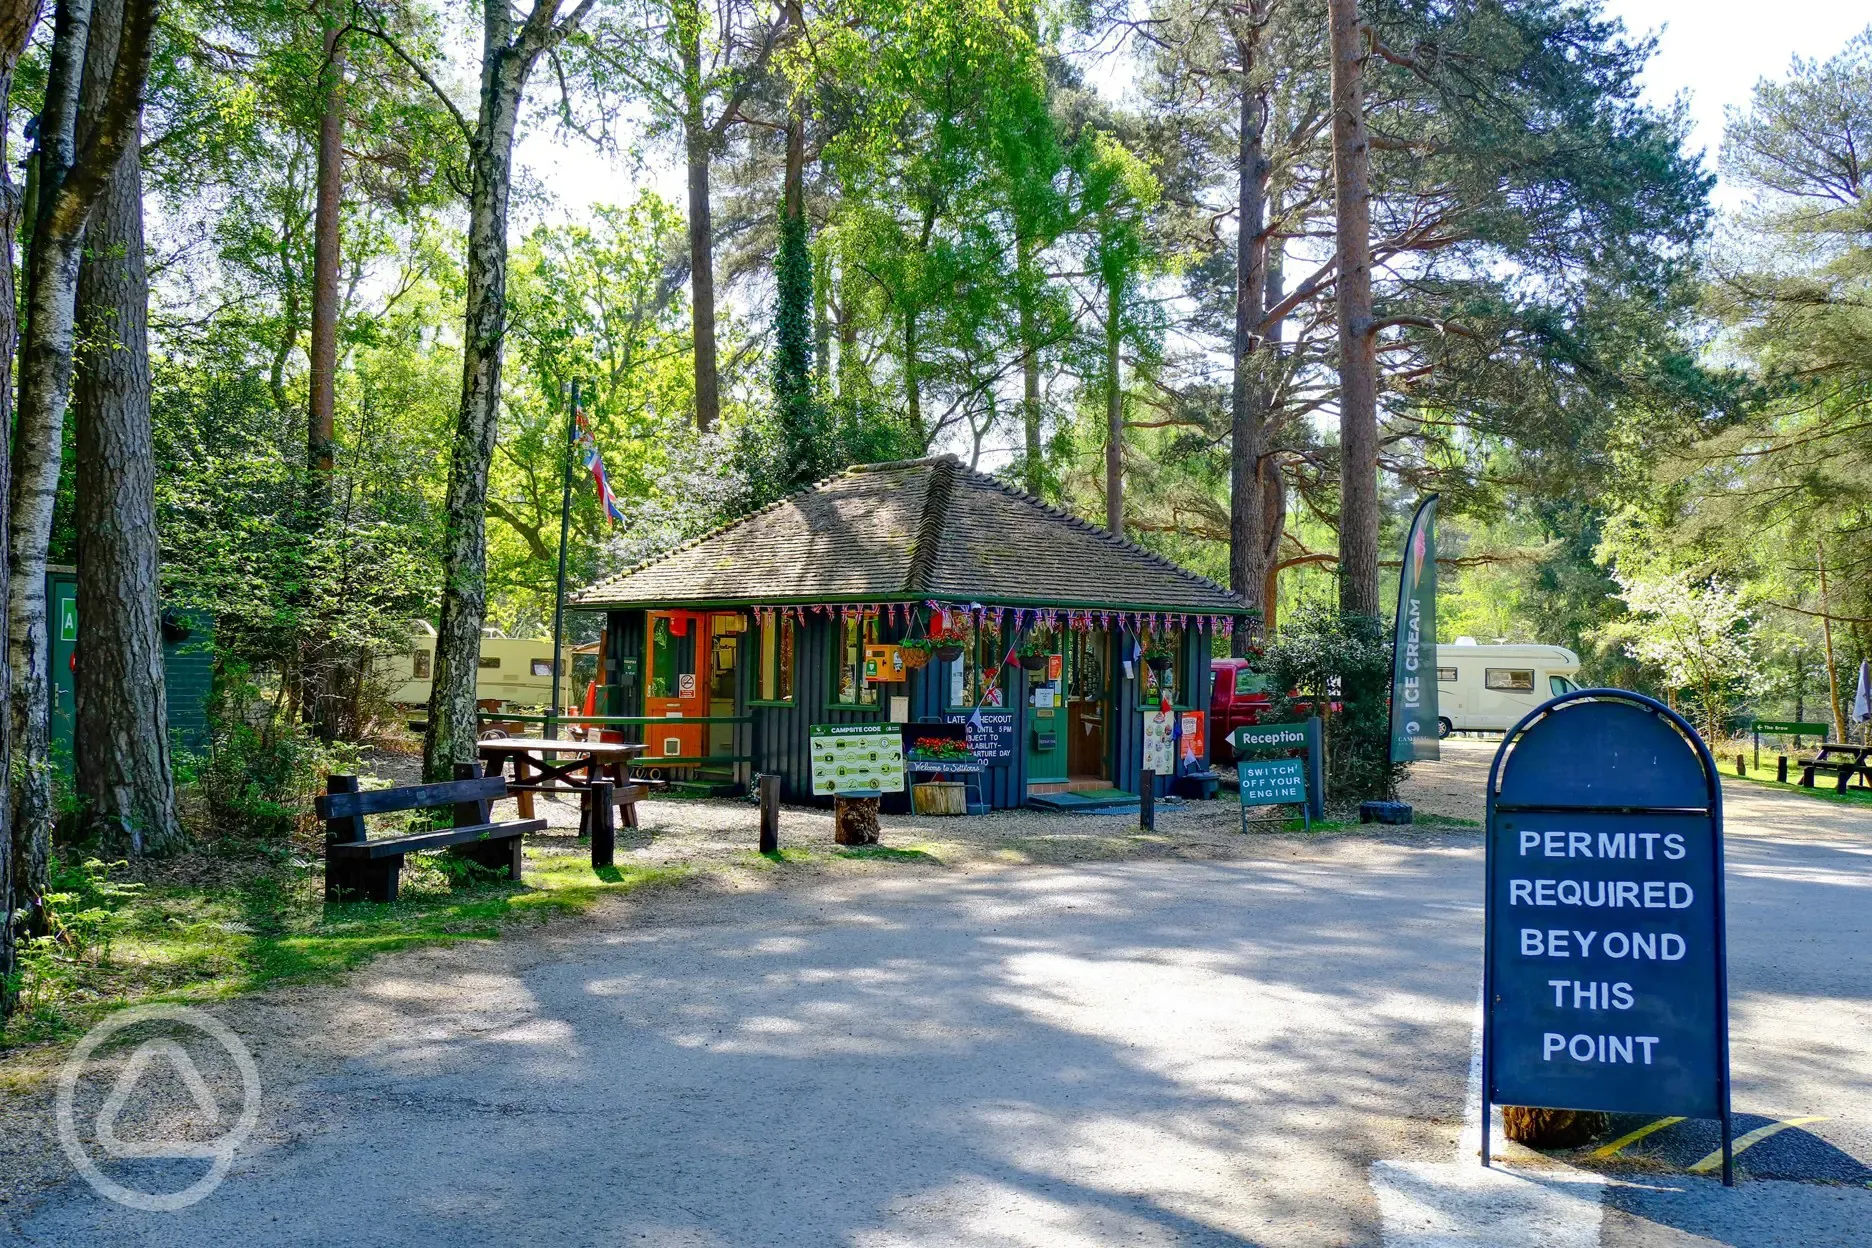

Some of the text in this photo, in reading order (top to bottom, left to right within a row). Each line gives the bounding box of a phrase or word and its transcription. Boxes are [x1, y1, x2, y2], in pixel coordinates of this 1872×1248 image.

[65, 612, 74, 629] A
[1405, 599, 1420, 708] ICE CREAM
[947, 715, 1012, 724] LATE HECKOUT
[1243, 731, 1304, 745] Reception
[1243, 777, 1300, 788] OFF YOUR
[1248, 766, 1294, 777] SWITCH
[1250, 788, 1296, 798] ENGINE
[1520, 831, 1686, 860] PERMITS
[1509, 879, 1694, 909] REQUIRED
[1520, 928, 1686, 961] BEYOND
[1548, 980, 1635, 1010] THIS
[1543, 1033, 1660, 1065] POINT
